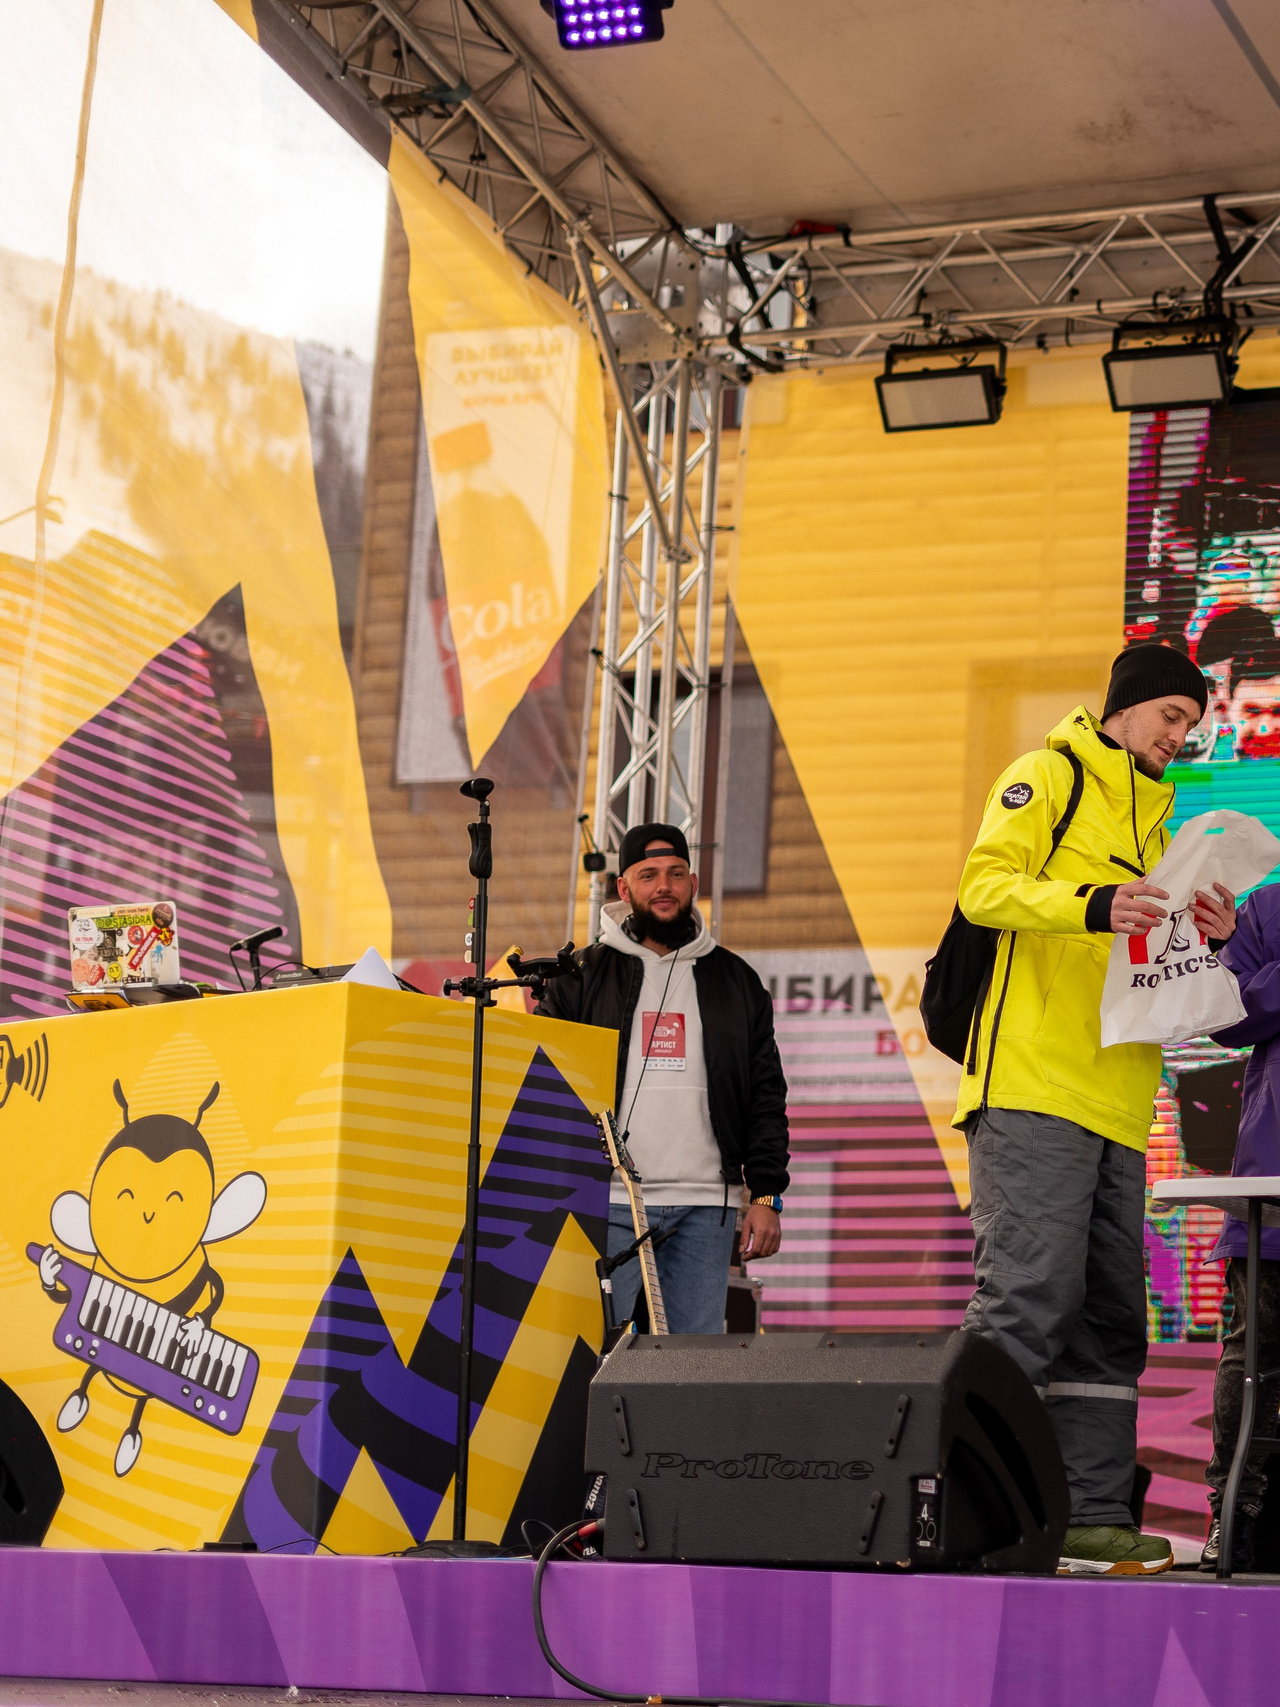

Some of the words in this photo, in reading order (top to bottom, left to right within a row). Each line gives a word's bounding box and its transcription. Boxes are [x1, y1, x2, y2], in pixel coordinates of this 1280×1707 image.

[440, 582, 551, 652] Cola
[1130, 953, 1220, 988] ROTIC'S
[769, 973, 922, 1014] БИРА
[651, 1040, 677, 1049] АРТИСТ
[876, 1026, 928, 1058] БО
[640, 1452, 874, 1480] ProTone
[921, 1503, 929, 1521] 4
